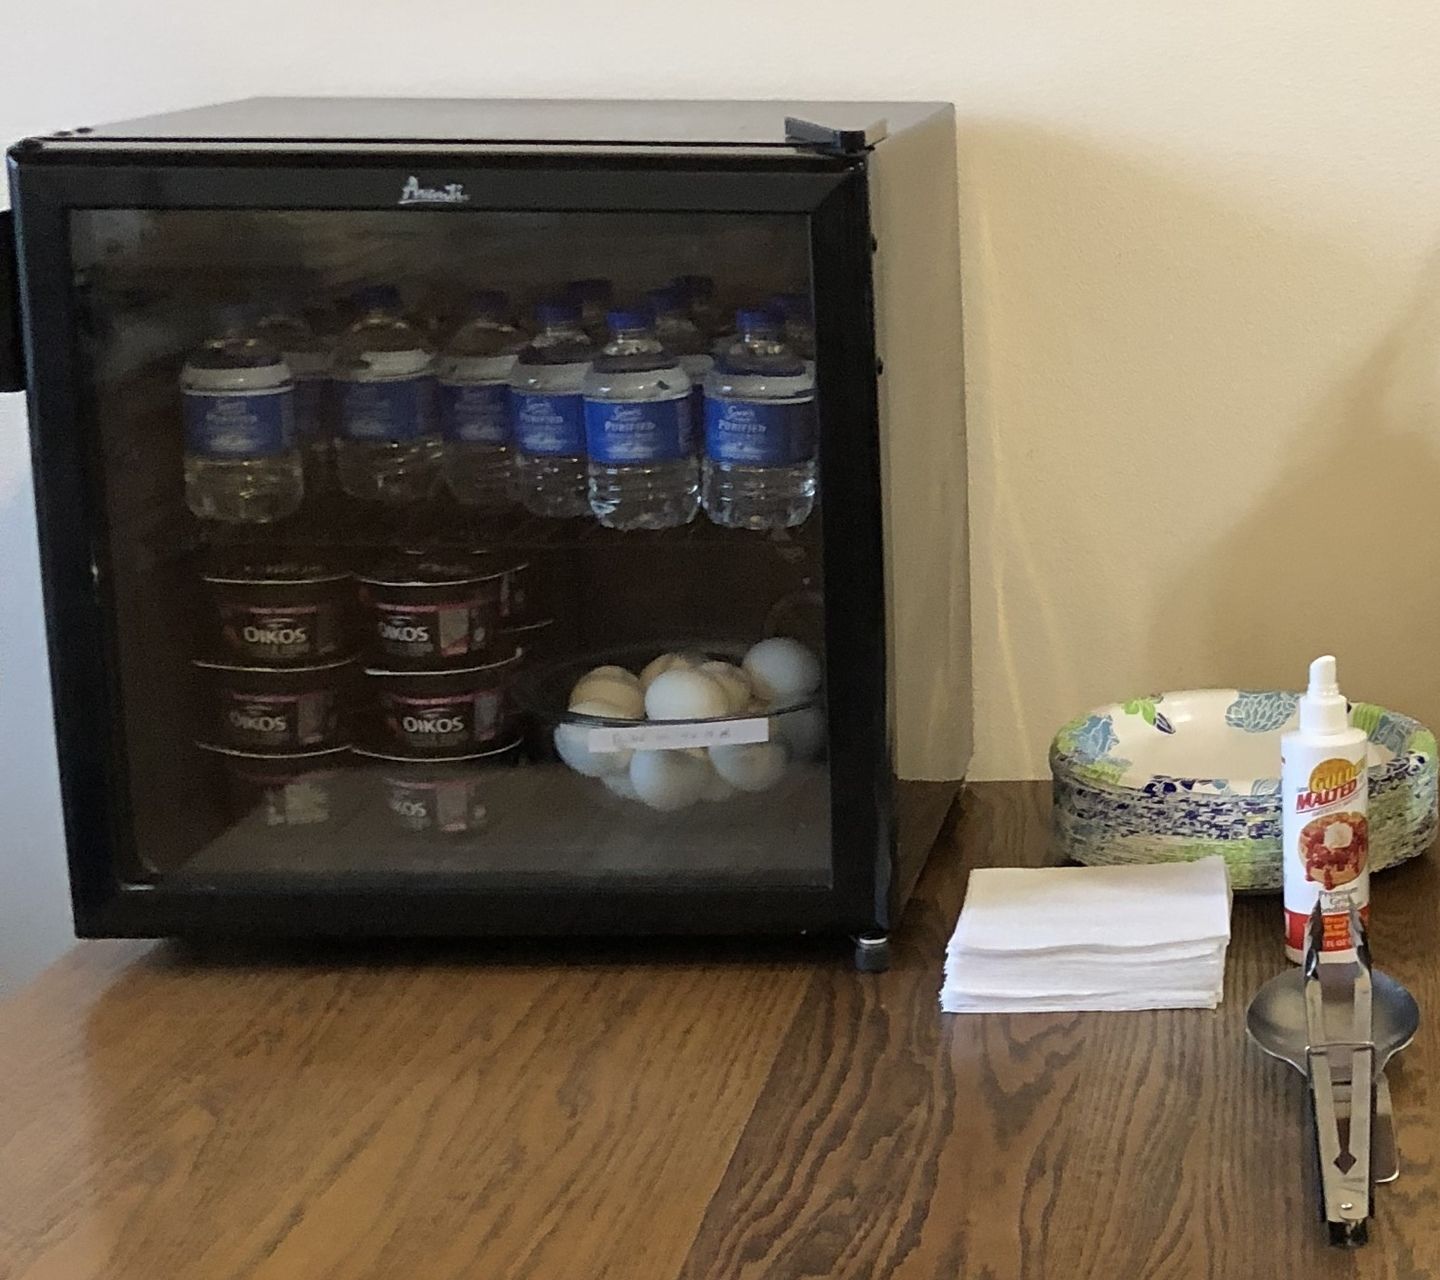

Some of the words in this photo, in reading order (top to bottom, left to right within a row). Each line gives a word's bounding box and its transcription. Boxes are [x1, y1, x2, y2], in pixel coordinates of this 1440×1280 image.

[243, 626, 307, 645] OIKOS
[402, 716, 465, 734] OIKOS
[1296, 778, 1357, 811] MALTED
